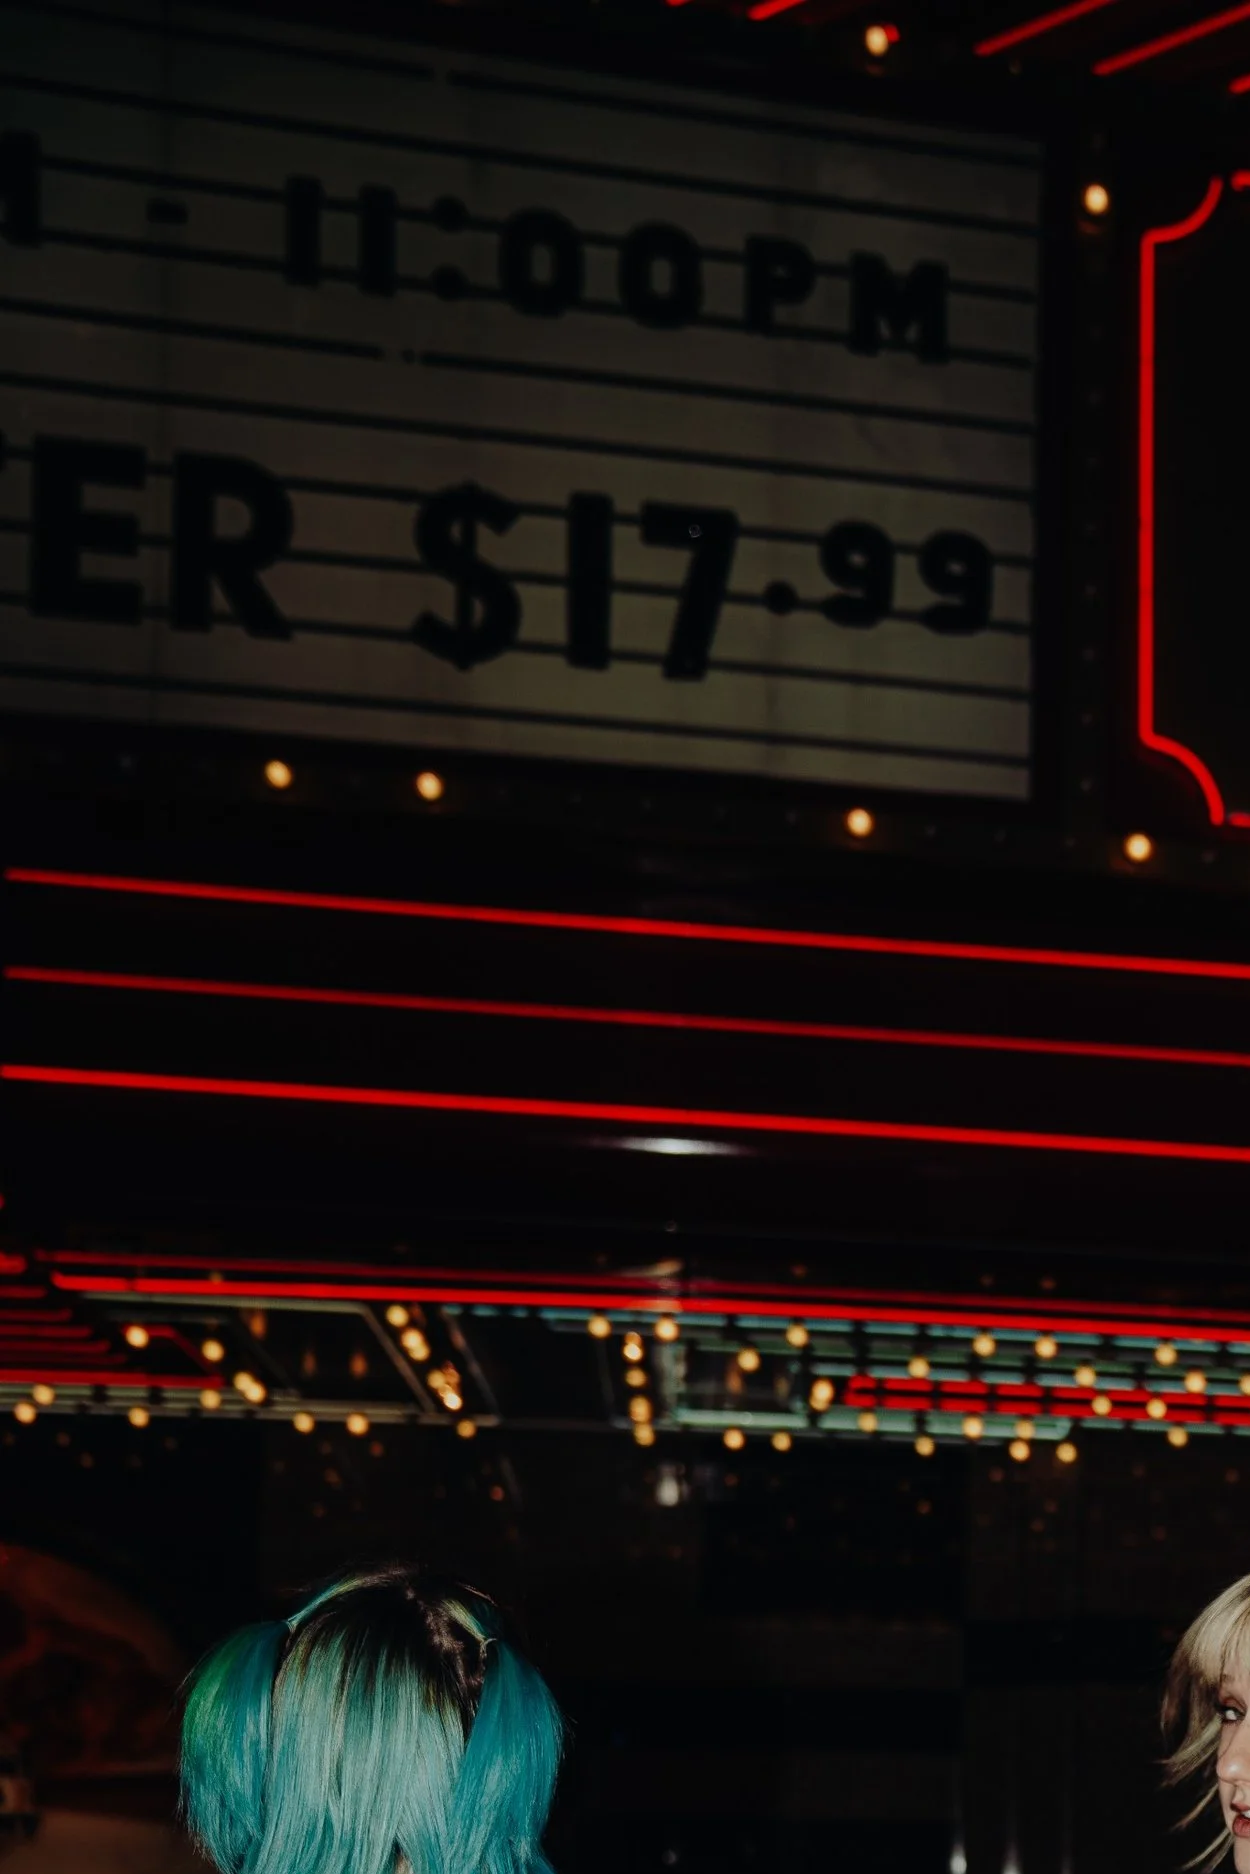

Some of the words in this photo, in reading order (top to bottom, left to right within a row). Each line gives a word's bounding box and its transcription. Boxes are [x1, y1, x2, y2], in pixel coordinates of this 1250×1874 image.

[285, 176, 950, 363] 11:00PM
[0, 436, 294, 641] ER
[411, 482, 993, 680] $17.99
